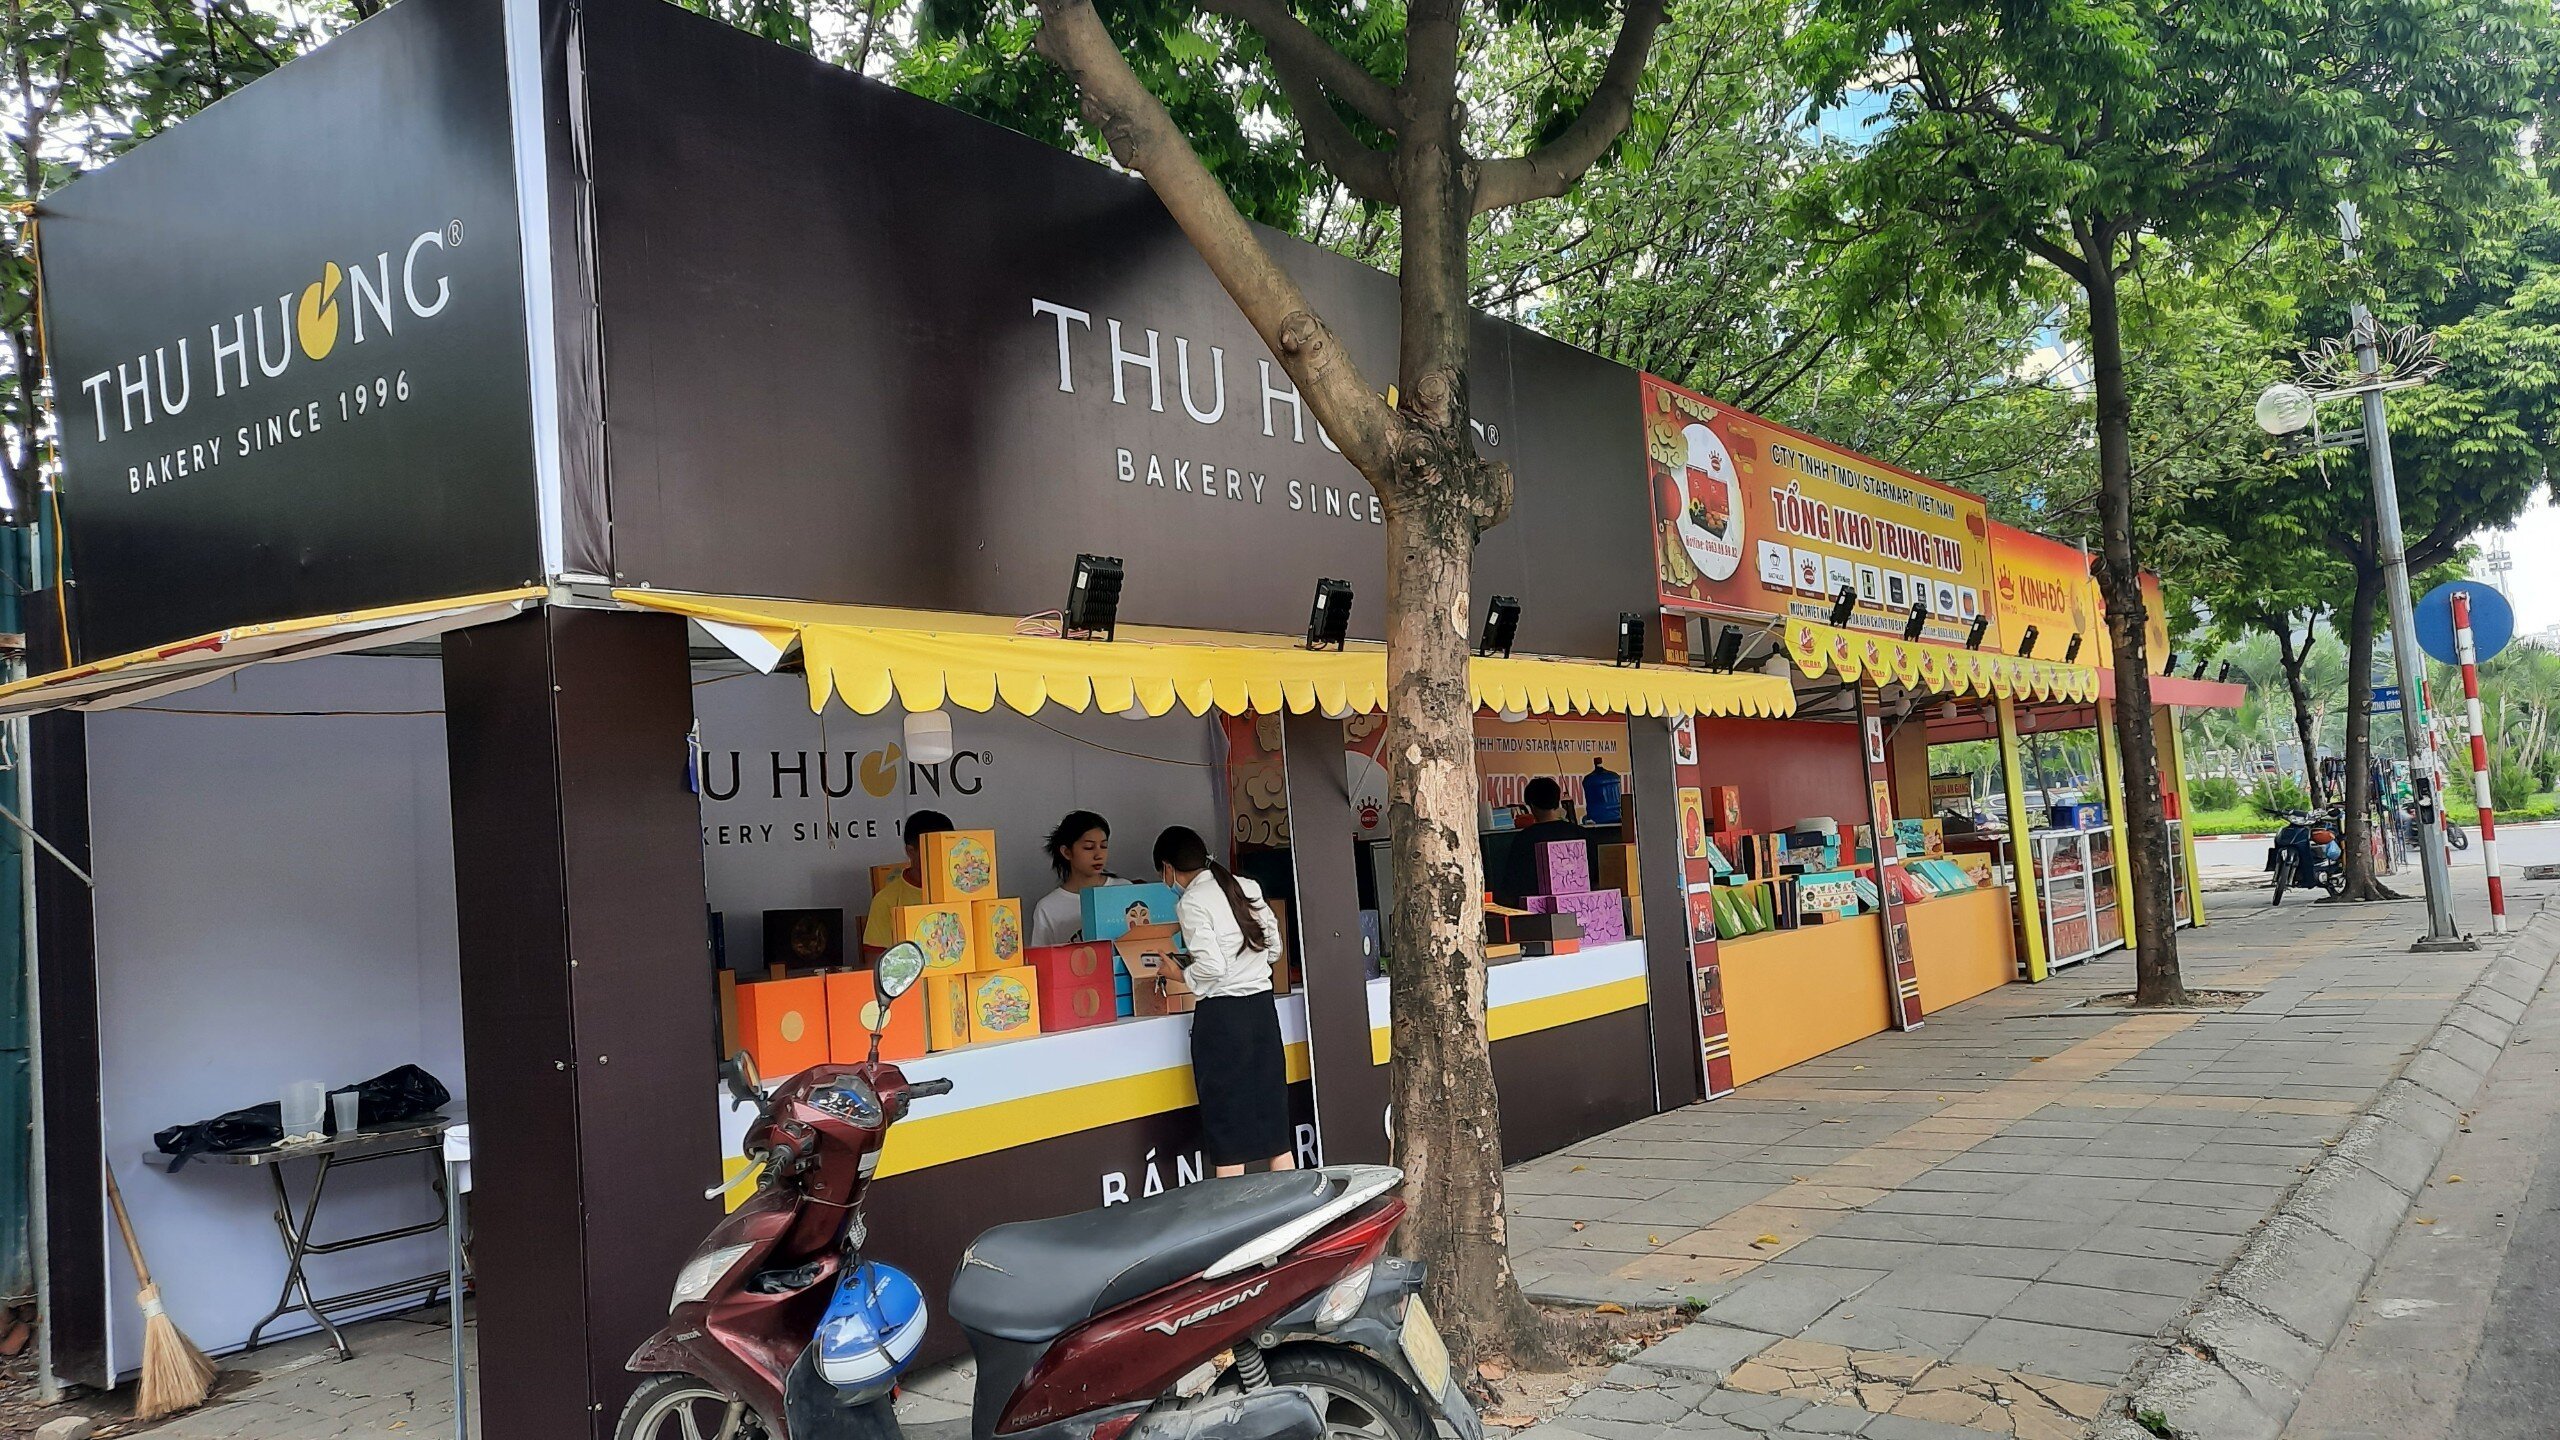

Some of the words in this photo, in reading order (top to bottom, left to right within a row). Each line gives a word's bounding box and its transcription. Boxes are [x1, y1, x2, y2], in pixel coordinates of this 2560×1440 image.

[82, 337, 191, 442] THU
[1032, 298, 1226, 425] THU
[129, 436, 222, 494] BAKERY
[238, 401, 321, 457] SINCE
[339, 369, 411, 421] 1996
[1116, 448, 1266, 504] BAKERY
[1288, 480, 1382, 524] SINCE
[1771, 443, 1796, 469] CTY
[1798, 453, 1829, 480] TNHH
[1831, 465, 1861, 490] TMDV
[1863, 475, 1915, 508] STARMART
[1937, 503, 1956, 520] NAM
[1771, 480, 1830, 542] TỔNG
[1833, 506, 1874, 553] KHO
[1874, 519, 1933, 567] TRUNG
[1933, 536, 1963, 574] THU
[1474, 737, 1494, 751] NHH
[1496, 738, 1525, 752] TMDV
[1525, 738, 1575, 752] STARMART
[1598, 740, 1617, 752] NAM
[794, 819, 878, 842] SINCE
[1101, 1146, 1204, 1207] BÁN
[1144, 1281, 1270, 1336] VISION
